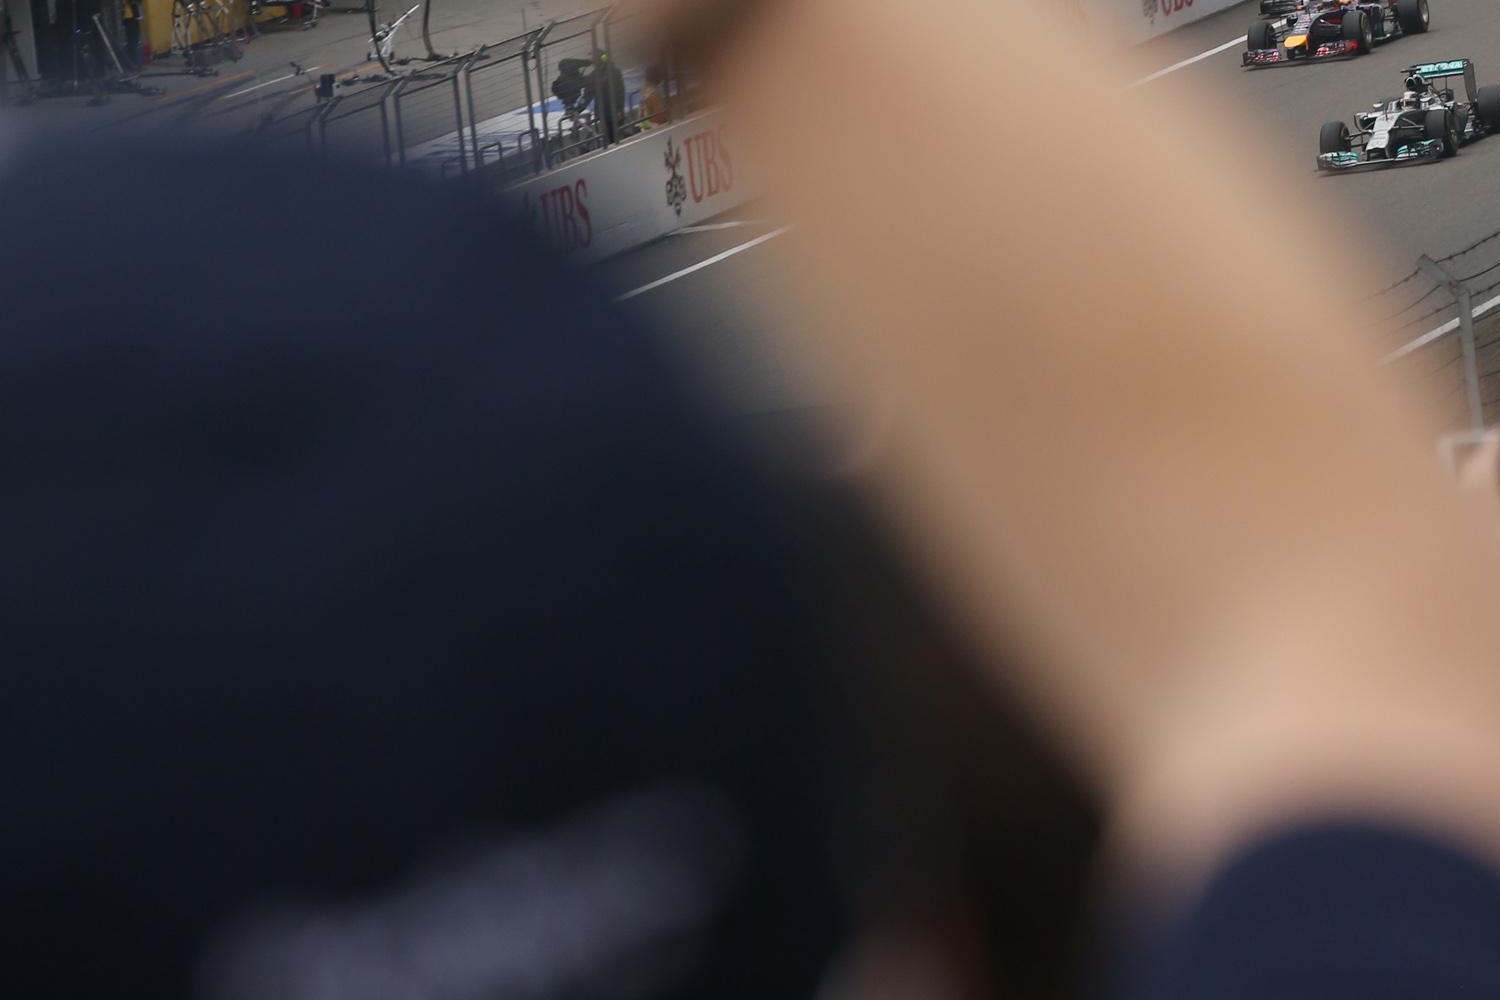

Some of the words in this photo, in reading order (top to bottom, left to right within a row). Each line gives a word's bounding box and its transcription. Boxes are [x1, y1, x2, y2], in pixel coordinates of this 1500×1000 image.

[1418, 61, 1463, 73] ETRONA
[684, 124, 734, 203] UBS
[540, 178, 592, 251] UBS
